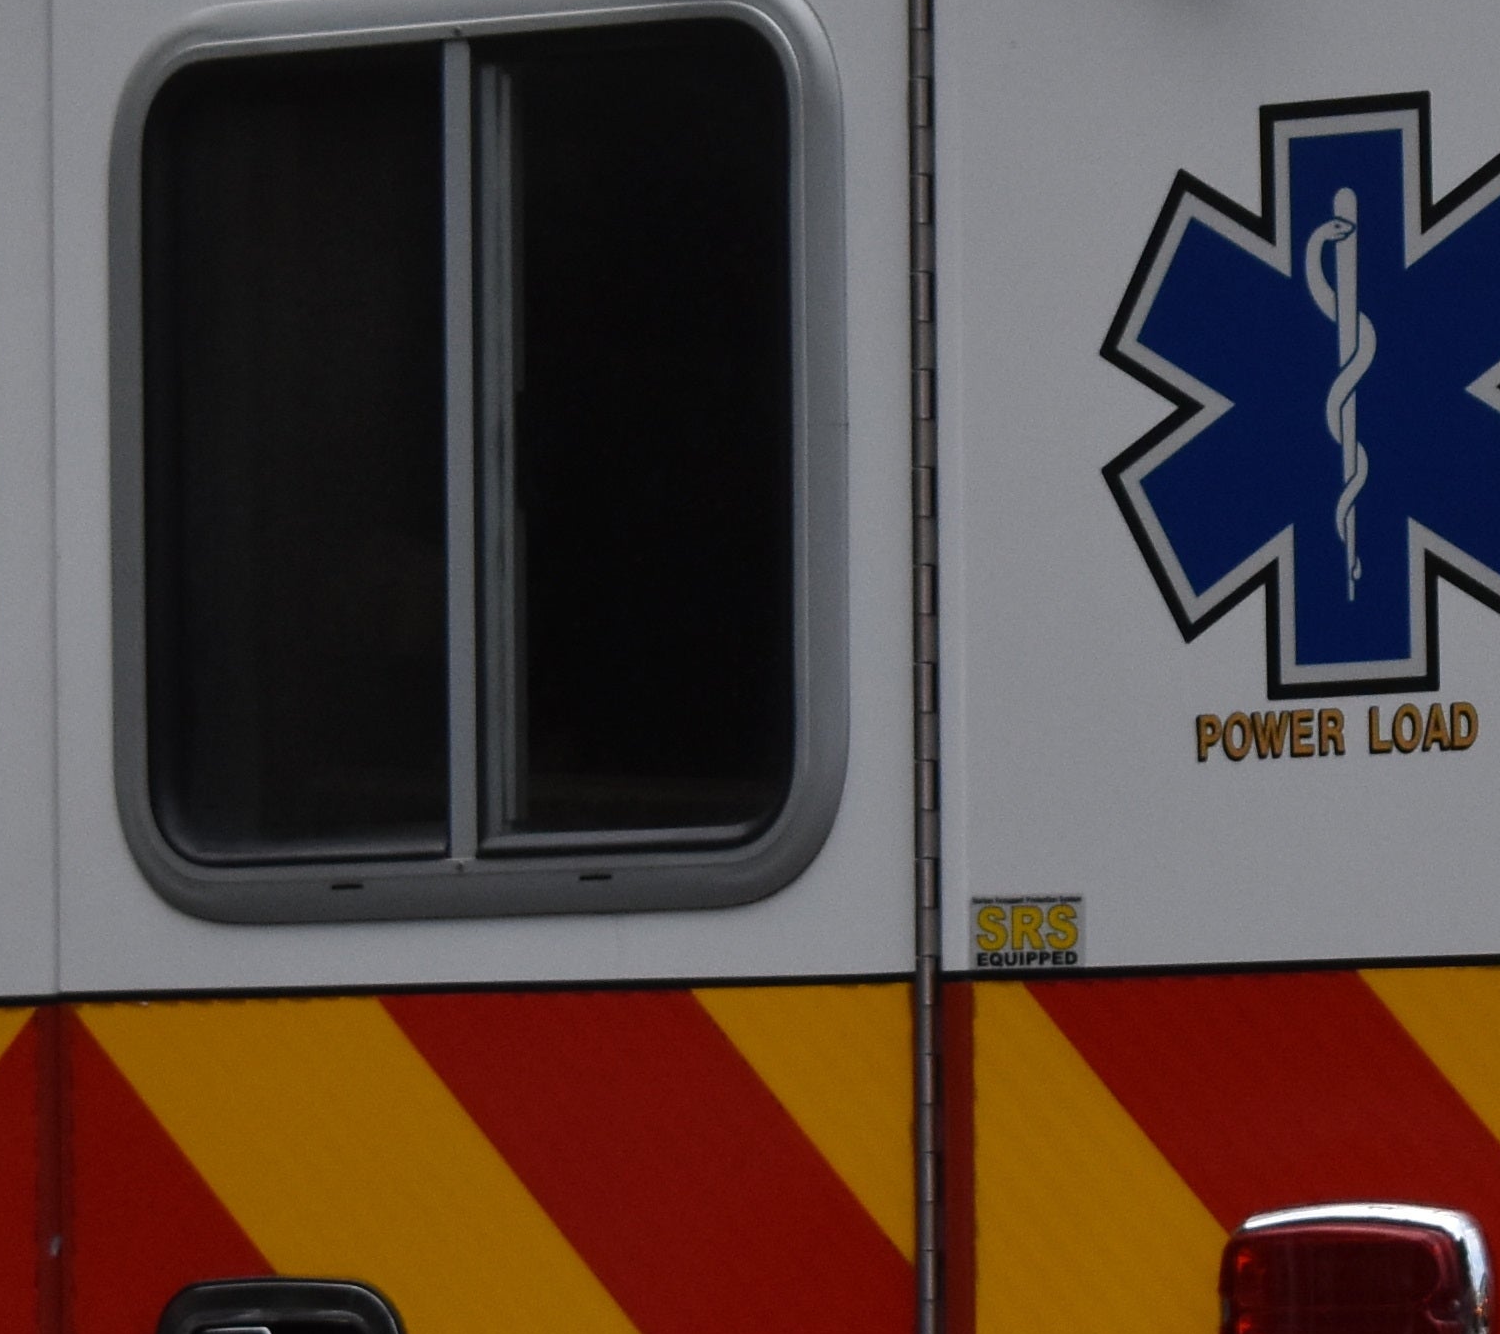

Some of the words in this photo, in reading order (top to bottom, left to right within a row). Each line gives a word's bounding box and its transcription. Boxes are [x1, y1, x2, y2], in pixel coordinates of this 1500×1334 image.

[1195, 707, 1346, 763] POWER
[1368, 702, 1479, 754] LOAD
[976, 903, 1079, 952] SRS
[976, 950, 1079, 967] EQUIPPED
